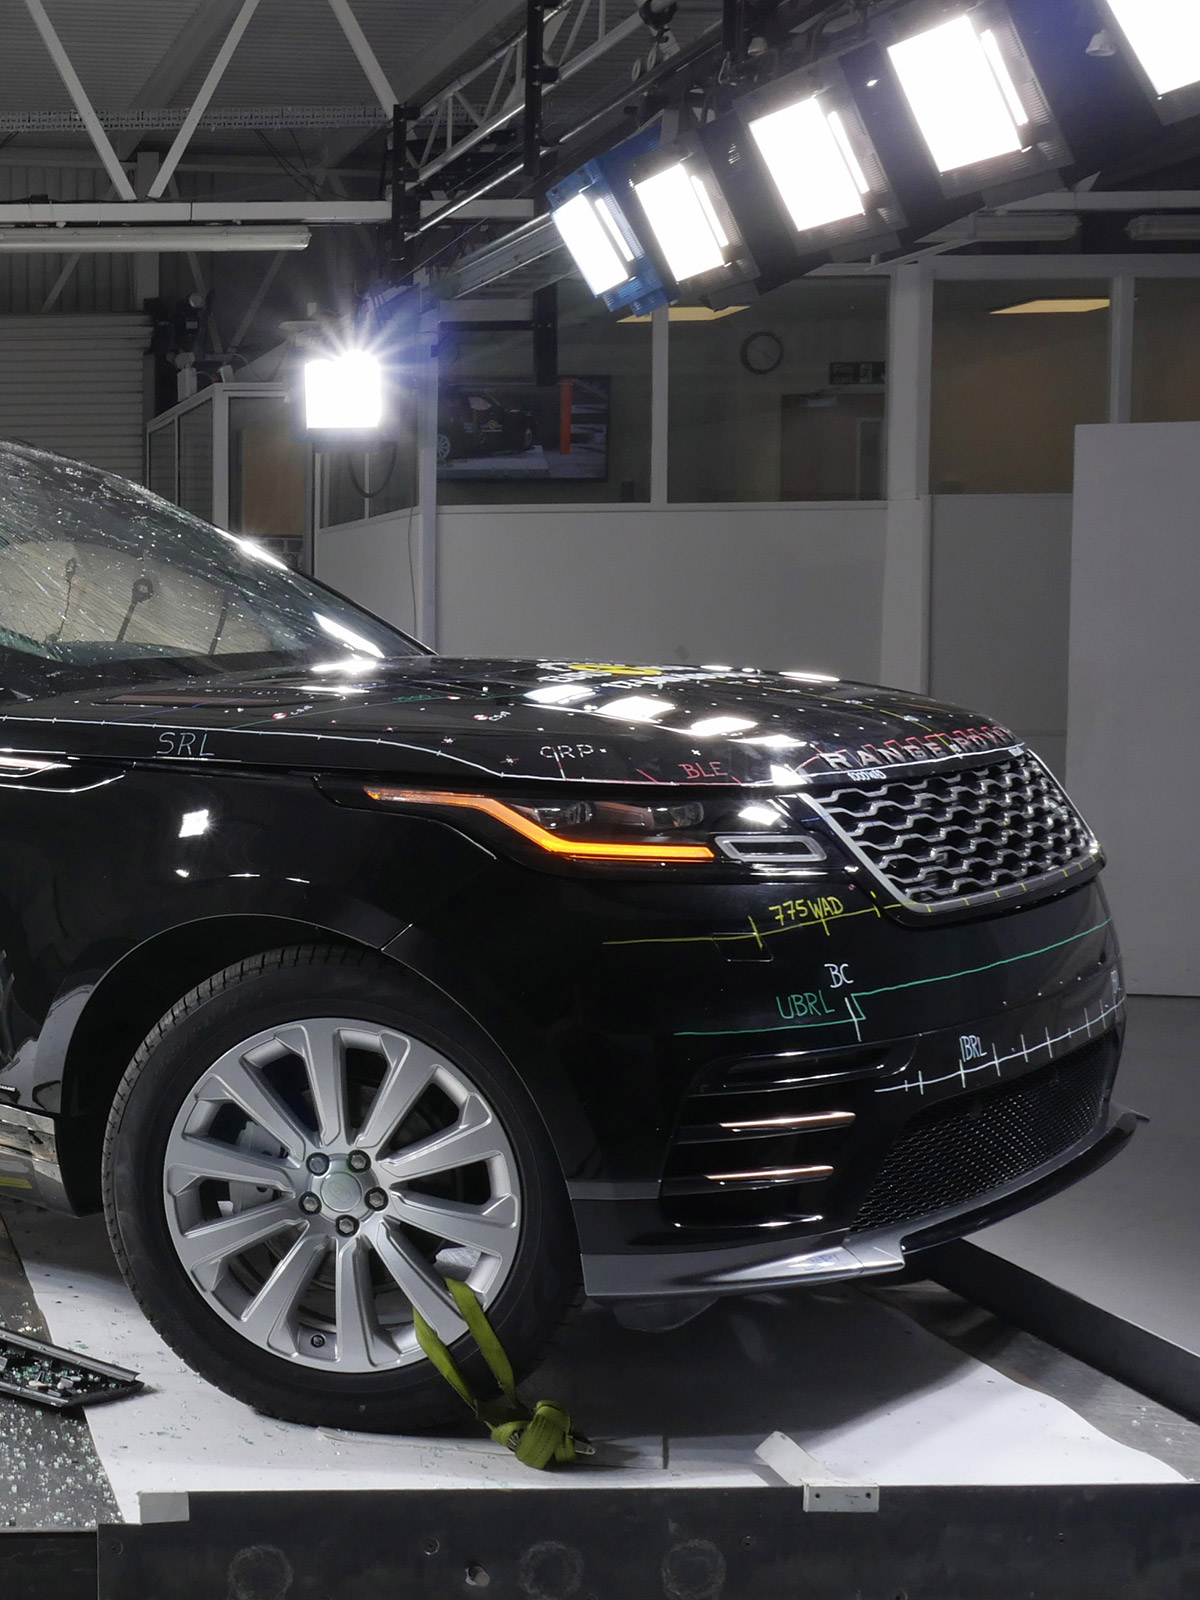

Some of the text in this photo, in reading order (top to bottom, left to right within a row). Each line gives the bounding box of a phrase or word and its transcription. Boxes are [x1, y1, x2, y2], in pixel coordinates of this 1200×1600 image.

[156, 731, 215, 756] SRL
[818, 741, 947, 771] RANGE
[678, 761, 728, 780] BLE
[768, 896, 844, 926] 775WAD
[823, 963, 854, 988] BC
[775, 989, 836, 1020] UBRL
